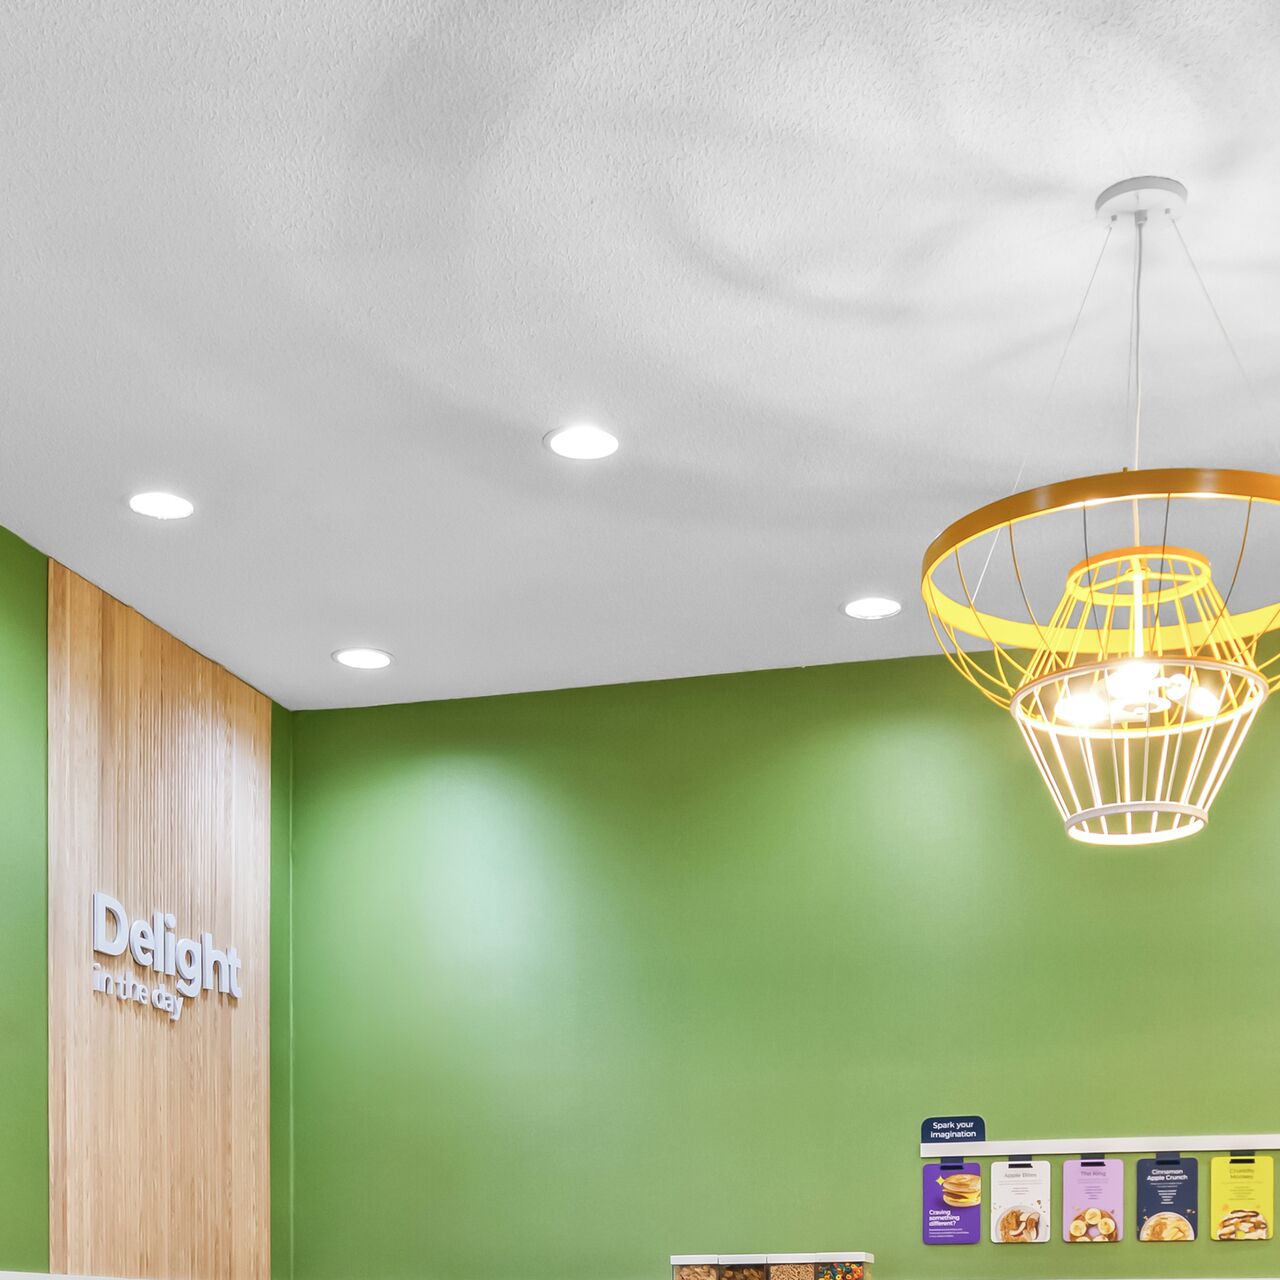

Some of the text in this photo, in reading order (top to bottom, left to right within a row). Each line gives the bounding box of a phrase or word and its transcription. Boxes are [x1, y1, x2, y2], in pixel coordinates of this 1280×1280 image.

[93, 892, 242, 999] Delight
[93, 963, 184, 1021] in the day
[932, 1121, 974, 1130] Spark your
[930, 1131, 977, 1139] imagination
[928, 1209, 951, 1217] Craving
